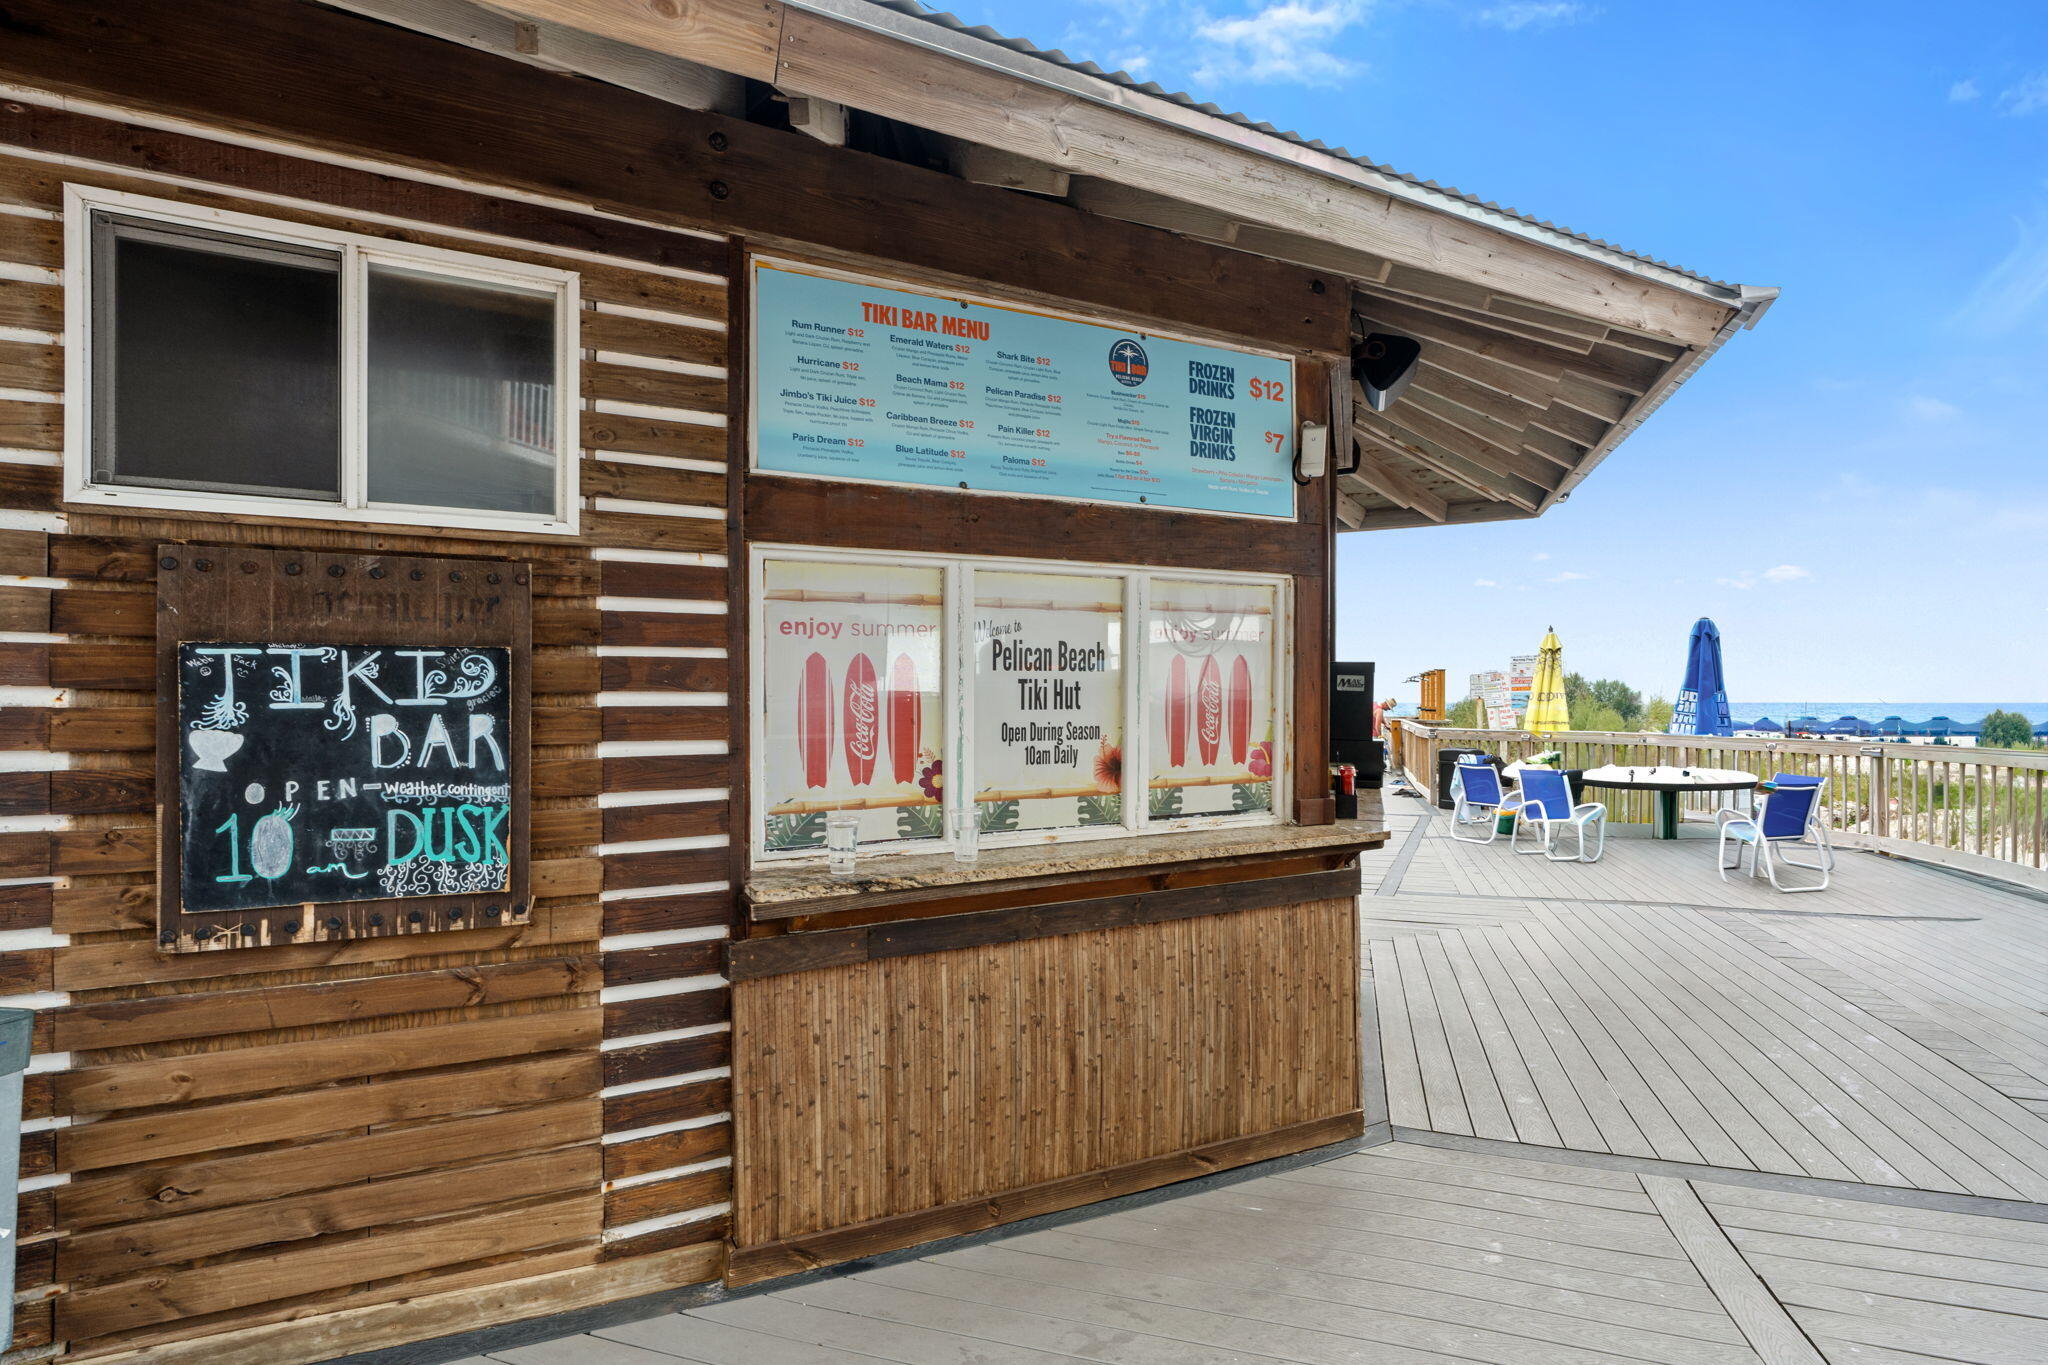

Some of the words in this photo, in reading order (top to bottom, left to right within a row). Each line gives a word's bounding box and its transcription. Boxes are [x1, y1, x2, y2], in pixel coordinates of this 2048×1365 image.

[792, 319, 812, 330] Rum
[814, 322, 846, 334] Runner
[847, 327, 864, 338] $12
[861, 301, 898, 327] TIKI
[901, 308, 938, 333] BAR
[941, 315, 990, 341] MENU
[889, 334, 924, 347] Emerald
[925, 339, 953, 351] Waters
[954, 344, 971, 354] $12
[797, 355, 841, 369] Hurricane
[842, 361, 860, 371] $12
[996, 350, 1019, 361] Shark
[1020, 354, 1035, 363] Bite
[1036, 356, 1051, 366] $12
[1110, 360, 1126, 373] TIKI
[896, 373, 922, 385] Beach
[923, 378, 948, 389] Mama
[949, 380, 965, 390] $12
[1188, 360, 1235, 384] FROZEN
[780, 388, 814, 401] Jimbo's
[816, 392, 832, 402] Tiki
[834, 395, 857, 405] Juice
[858, 397, 877, 407] $12
[985, 386, 1013, 397] Pelican
[1014, 390, 1046, 401] Paradise
[1047, 394, 1062, 404] $12
[1189, 377, 1235, 400] DRINKS
[1249, 376, 1284, 402] $12
[886, 411, 928, 424] Caribbean
[930, 416, 958, 427] Breeze
[959, 420, 975, 429] $12
[1189, 406, 1236, 428] FROZEN
[792, 432, 815, 443] Paris
[817, 435, 846, 445] Dream
[847, 438, 865, 447] $12
[997, 424, 1014, 434] Pain
[1015, 427, 1035, 436] Killer
[1036, 428, 1051, 438] $12
[1189, 423, 1233, 444] VIRGIN
[1264, 431, 1285, 453] $7
[895, 444, 914, 454] Blue
[915, 446, 949, 457] Latitude
[950, 449, 966, 459] $12
[1190, 440, 1236, 462] DRINKS
[1002, 455, 1030, 466] Paloma
[1031, 458, 1047, 467] $12
[779, 617, 843, 640] enjoy
[849, 622, 937, 639] summer
[1013, 620, 1022, 634] to
[233, 654, 258, 669] Jack
[992, 638, 1053, 672] Pelican
[1057, 640, 1105, 673] Beach
[195, 646, 500, 732] TIKI
[1017, 678, 1048, 711] Tiki
[1053, 678, 1082, 710] Hut
[367, 712, 505, 771] BAR
[1001, 722, 1027, 747] Open
[1029, 721, 1064, 746] During
[1066, 720, 1101, 742] Season
[1024, 745, 1051, 766] 10am
[1053, 744, 1079, 768] Daily
[386, 803, 511, 866] DUSK
[306, 862, 368, 879] am
